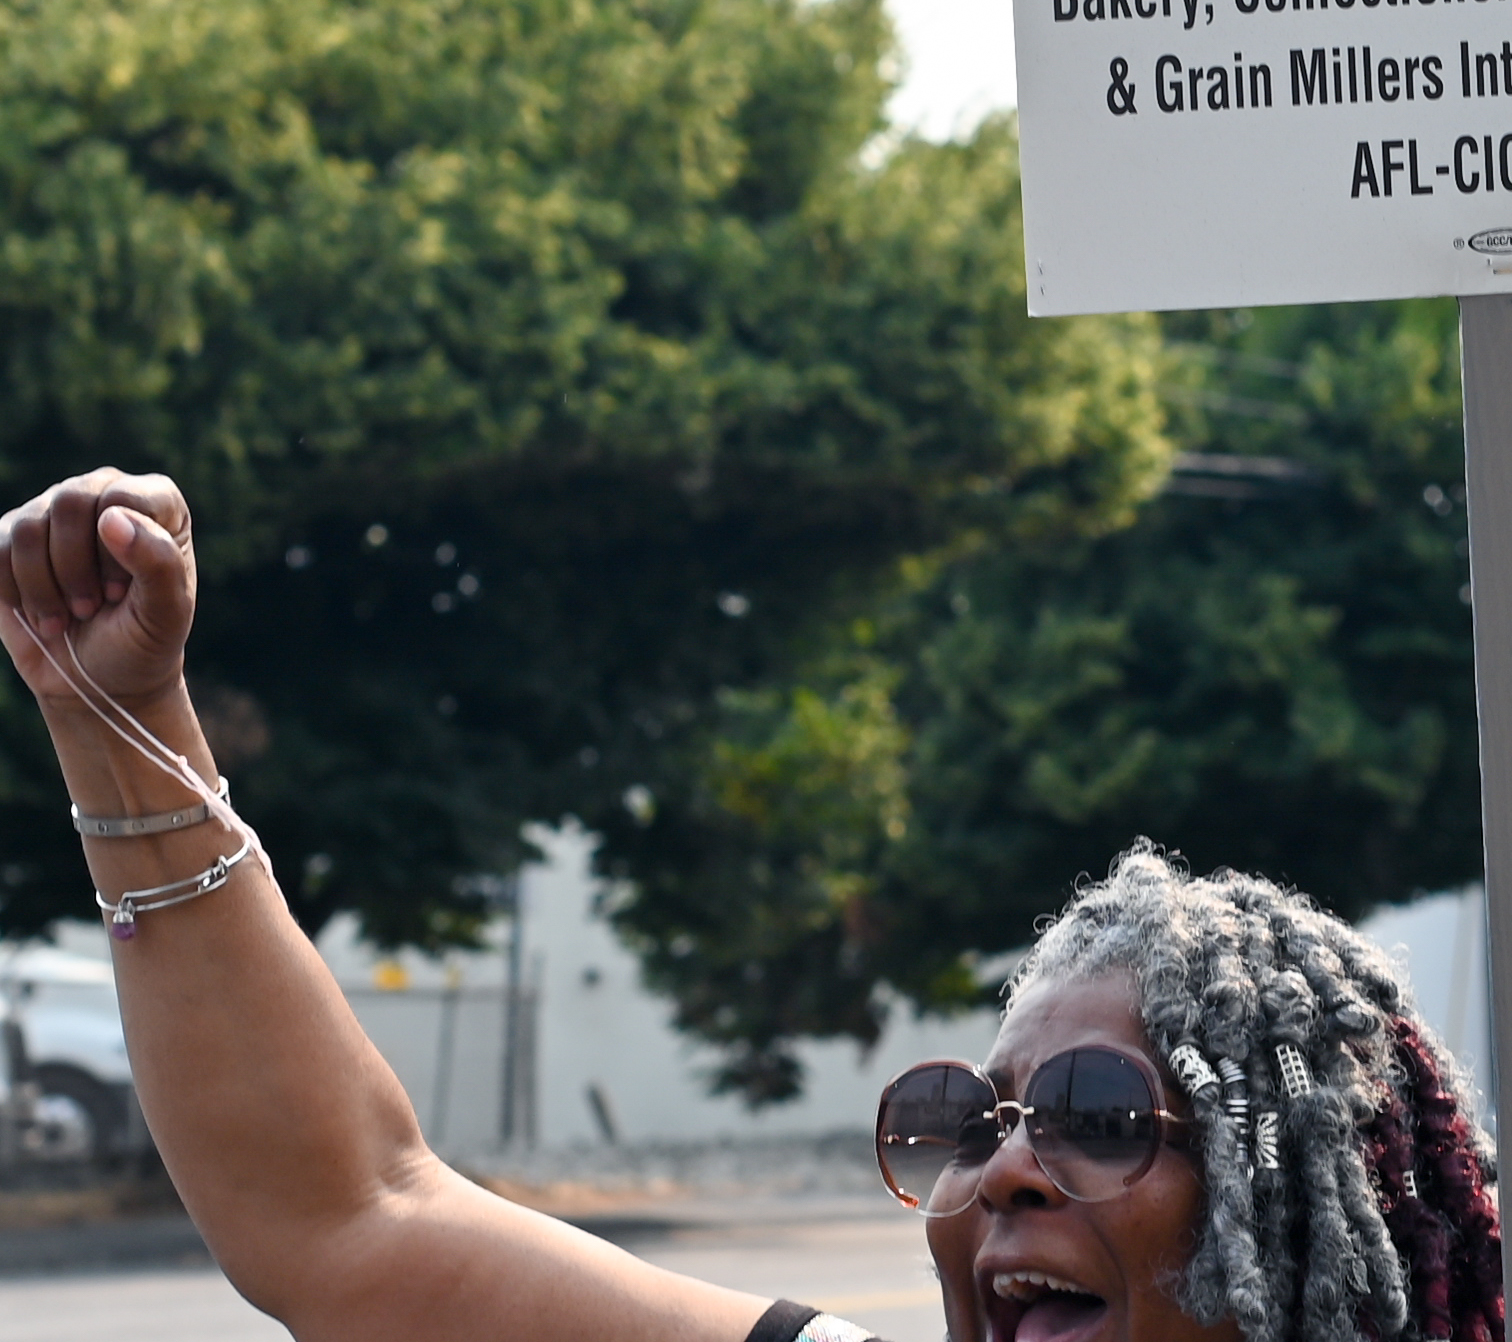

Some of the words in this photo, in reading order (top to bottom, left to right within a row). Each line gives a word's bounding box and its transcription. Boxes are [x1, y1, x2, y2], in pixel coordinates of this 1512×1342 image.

[1106, 56, 1138, 116] &
[1155, 52, 1273, 114] Grain
[1289, 45, 1444, 107] Millers
